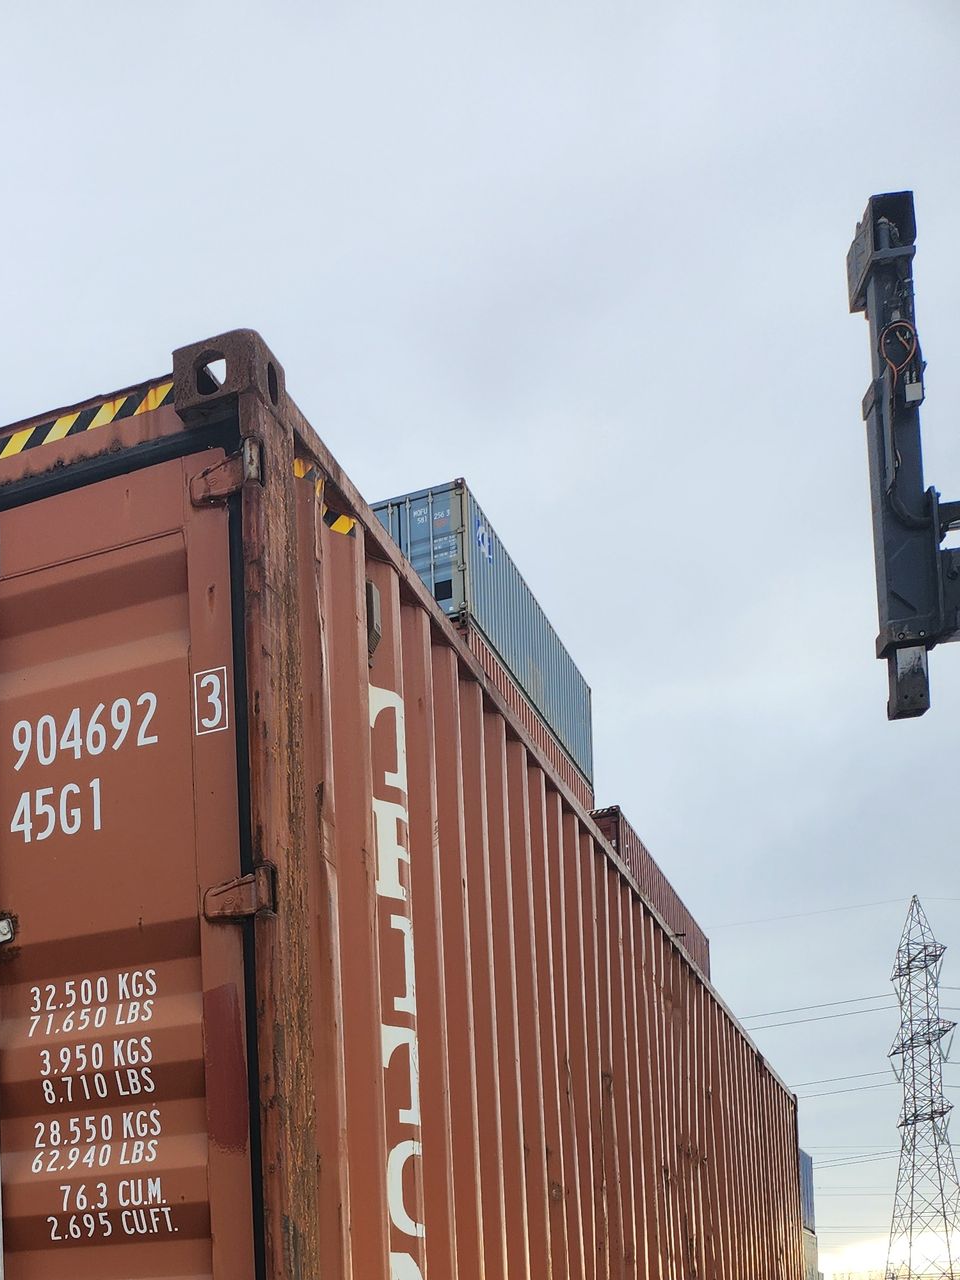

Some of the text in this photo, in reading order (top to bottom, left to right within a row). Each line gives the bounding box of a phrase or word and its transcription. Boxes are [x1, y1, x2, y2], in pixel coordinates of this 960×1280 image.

[11, 691, 159, 772] 904692
[200, 673, 223, 728] 3
[10, 777, 103, 843] 45G1
[117, 969, 158, 1000] KGS
[115, 999, 155, 1027] LBS
[113, 1036, 154, 1067] KGS
[115, 1067, 156, 1098] LBS
[122, 1108, 163, 1139] KGS
[119, 1139, 159, 1167] LBS
[59, 1182, 109, 1212] 76.3
[117, 1176, 167, 1207] CU.M.
[121, 1206, 180, 1237] CU.FT.
